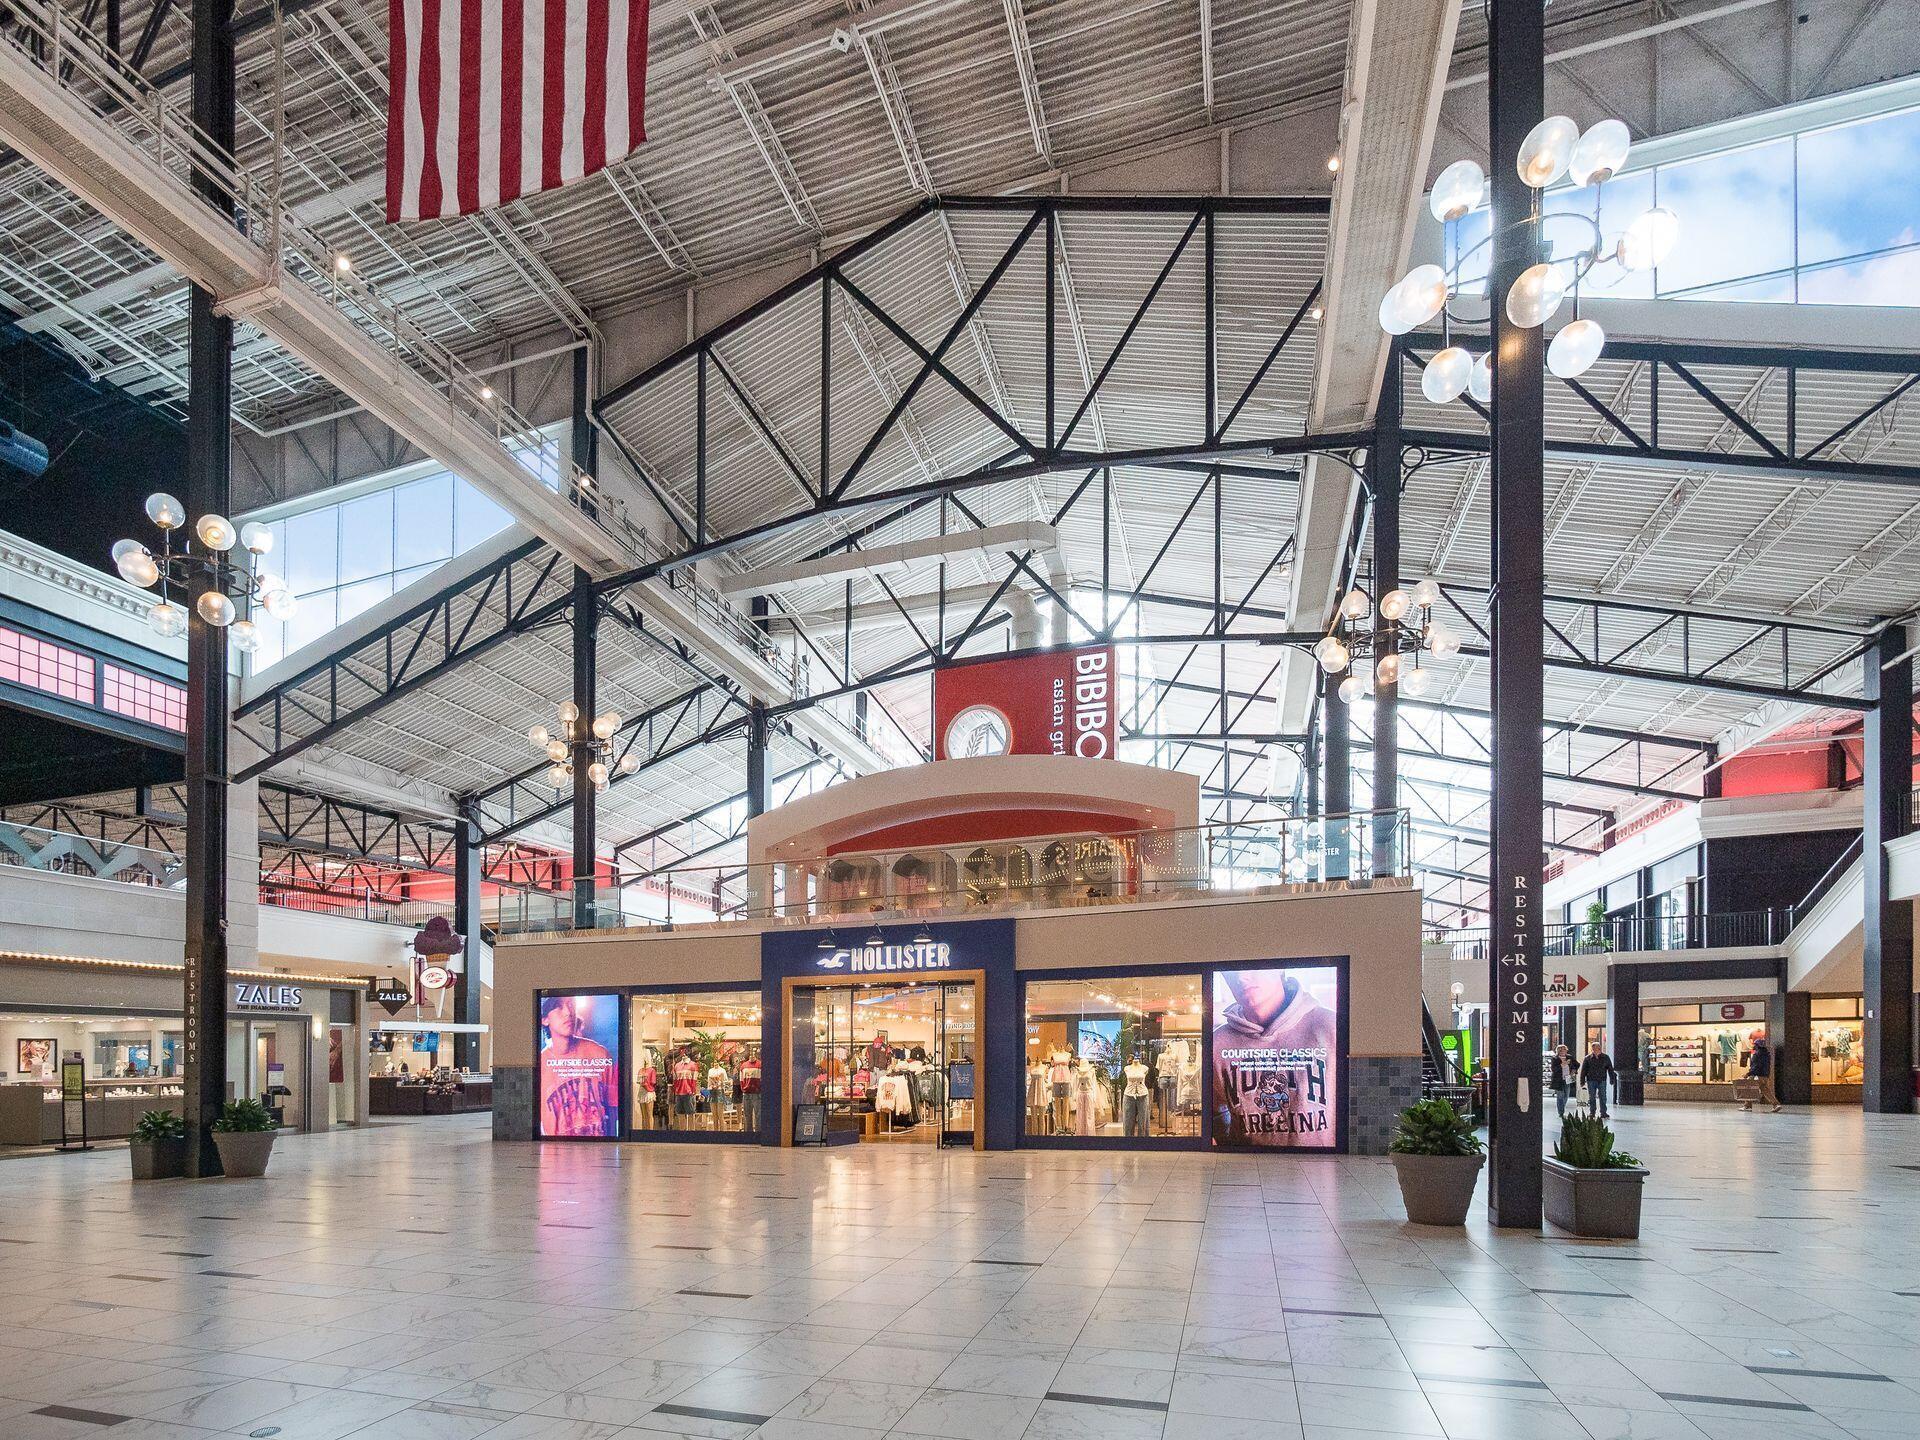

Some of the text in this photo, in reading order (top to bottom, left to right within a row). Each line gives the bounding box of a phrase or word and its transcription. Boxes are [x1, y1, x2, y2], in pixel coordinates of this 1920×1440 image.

[1053, 678, 1067, 727] asian
[851, 943, 950, 971] HOLLISTER
[1511, 876, 1529, 1043] RESTROOMS
[236, 984, 303, 1005] ZALES
[379, 992, 408, 1001] ZALES
[188, 958, 196, 1063] RESTROOMS
[546, 1058, 613, 1067] COURTSIDE CLASSICS
[1221, 1047, 1327, 1059] COURTSIDE CLASSICS
